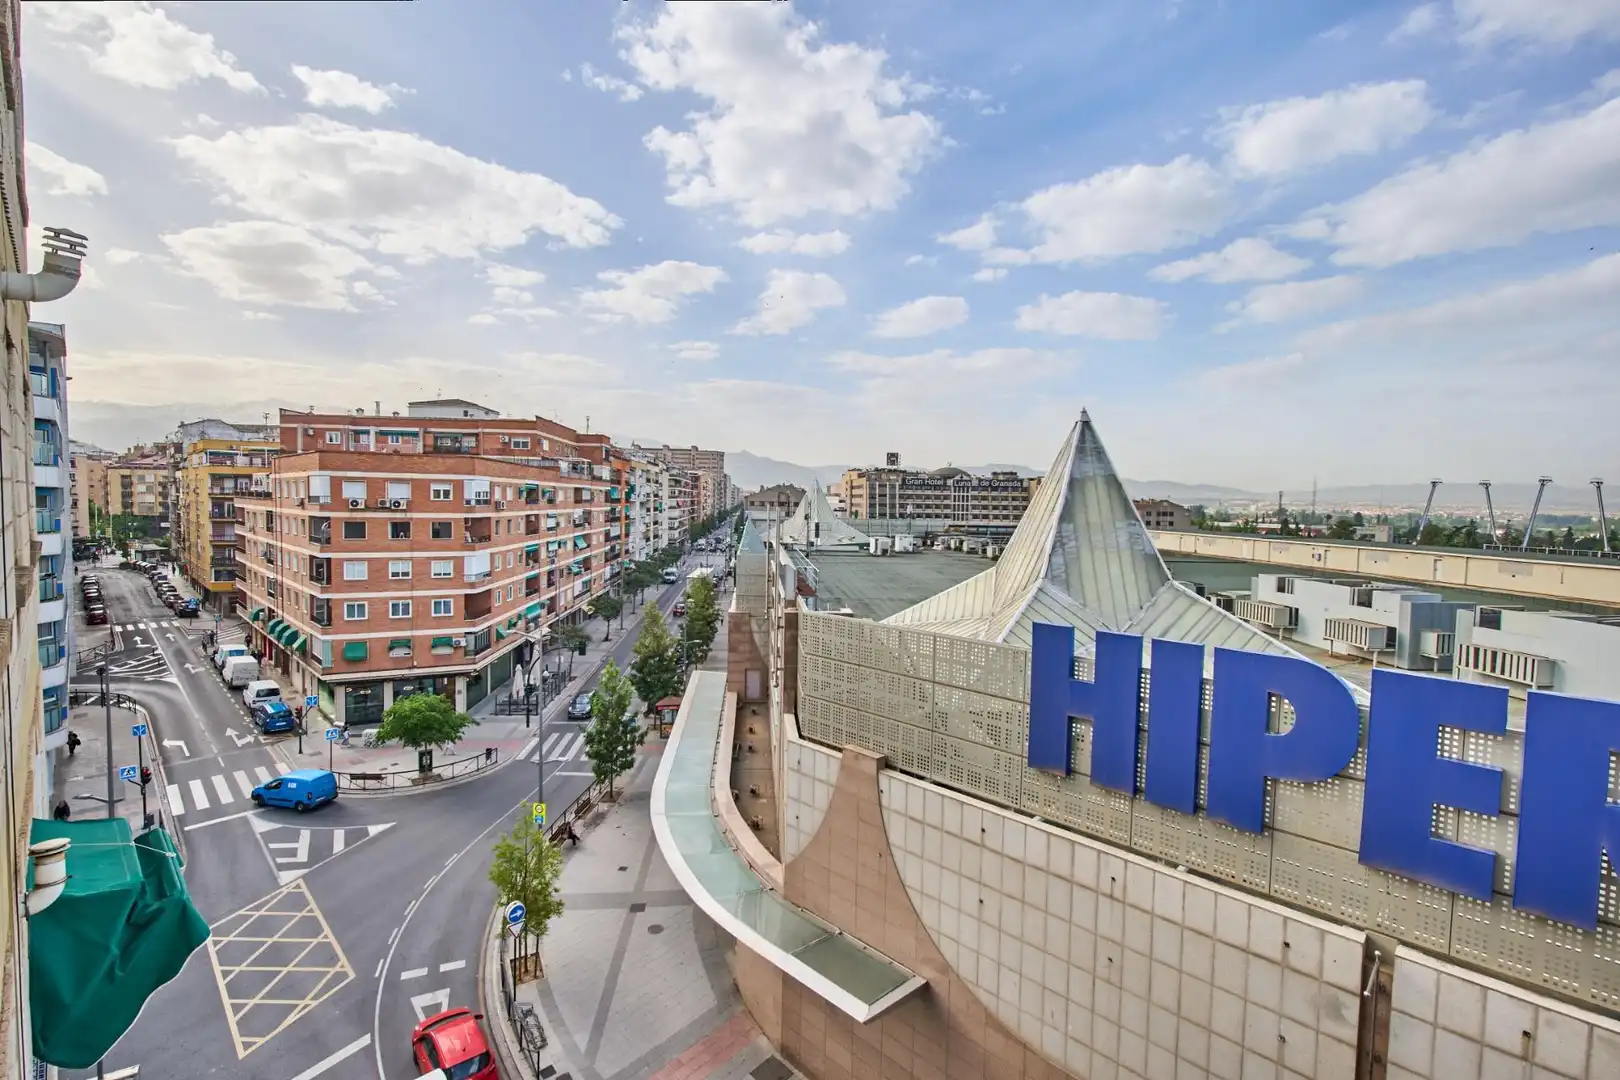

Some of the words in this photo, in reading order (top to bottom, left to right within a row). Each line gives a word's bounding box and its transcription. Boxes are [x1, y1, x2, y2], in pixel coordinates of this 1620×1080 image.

[954, 479, 971, 487] Luna
[980, 479, 989, 487] de
[991, 479, 1021, 487] Granada
